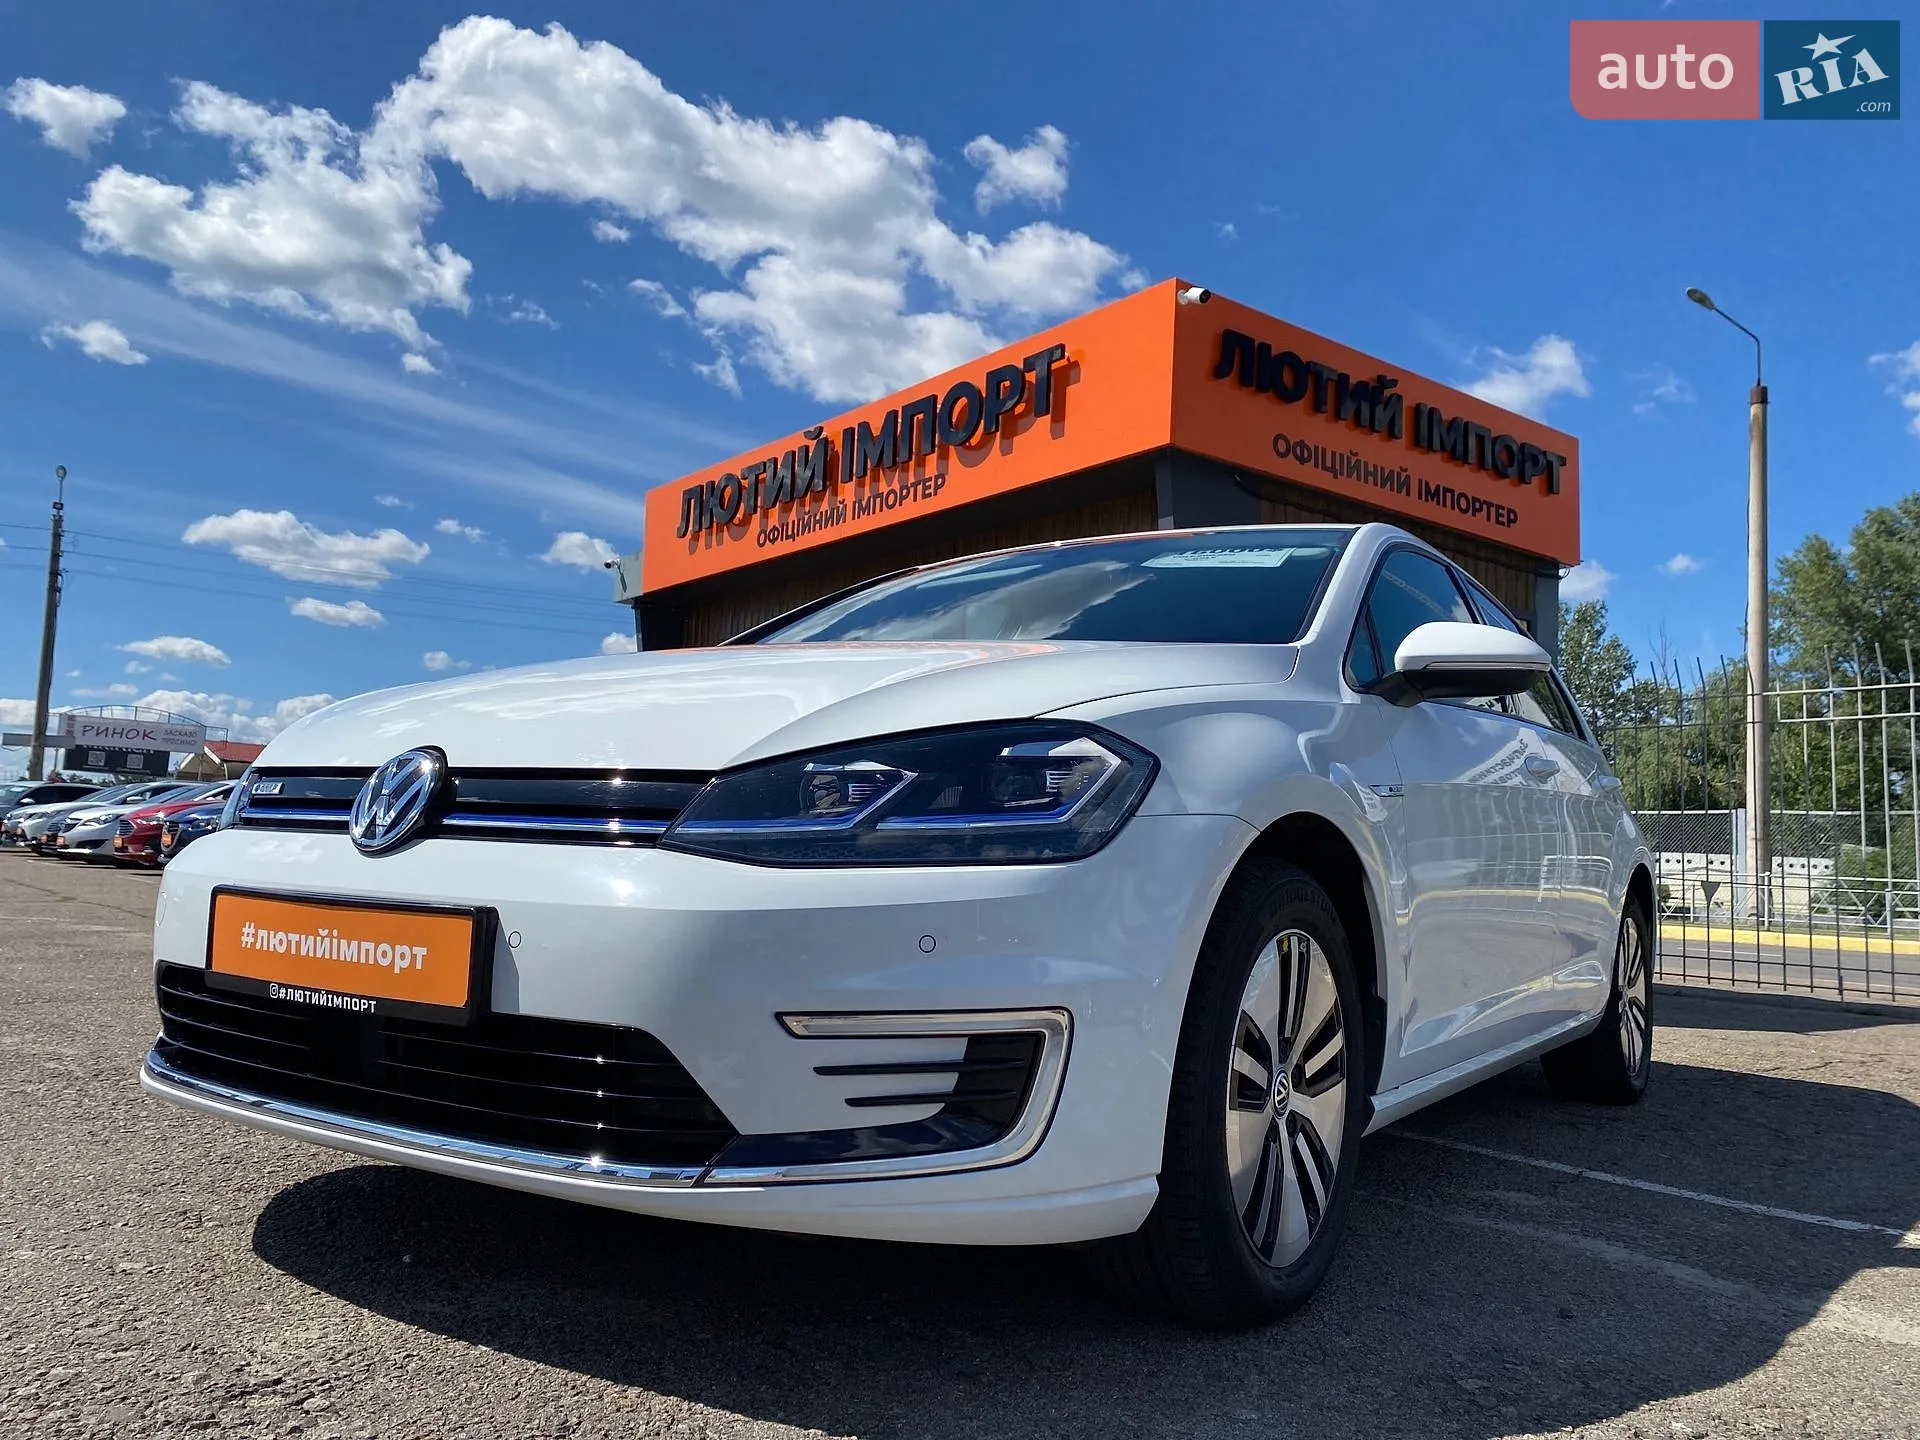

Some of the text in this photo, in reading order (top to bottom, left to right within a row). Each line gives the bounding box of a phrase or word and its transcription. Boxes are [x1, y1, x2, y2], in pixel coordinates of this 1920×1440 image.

[676, 342, 1067, 539] ЛЮТИЙ ІМПОРТ
[1213, 327, 1567, 496] ЛЮТИЙ ІМПОРТ
[756, 472, 946, 549] ОФІЦІЙНИЙ ІМПОРТЕР
[1272, 432, 1519, 529] ОФІЦІЙНИЙ ІМПОРТЕР
[81, 724, 157, 741] РИНОК
[240, 921, 428, 974] #лютийімпорт
[278, 986, 377, 1013] #ЛЮТИЙІМПОРТ
